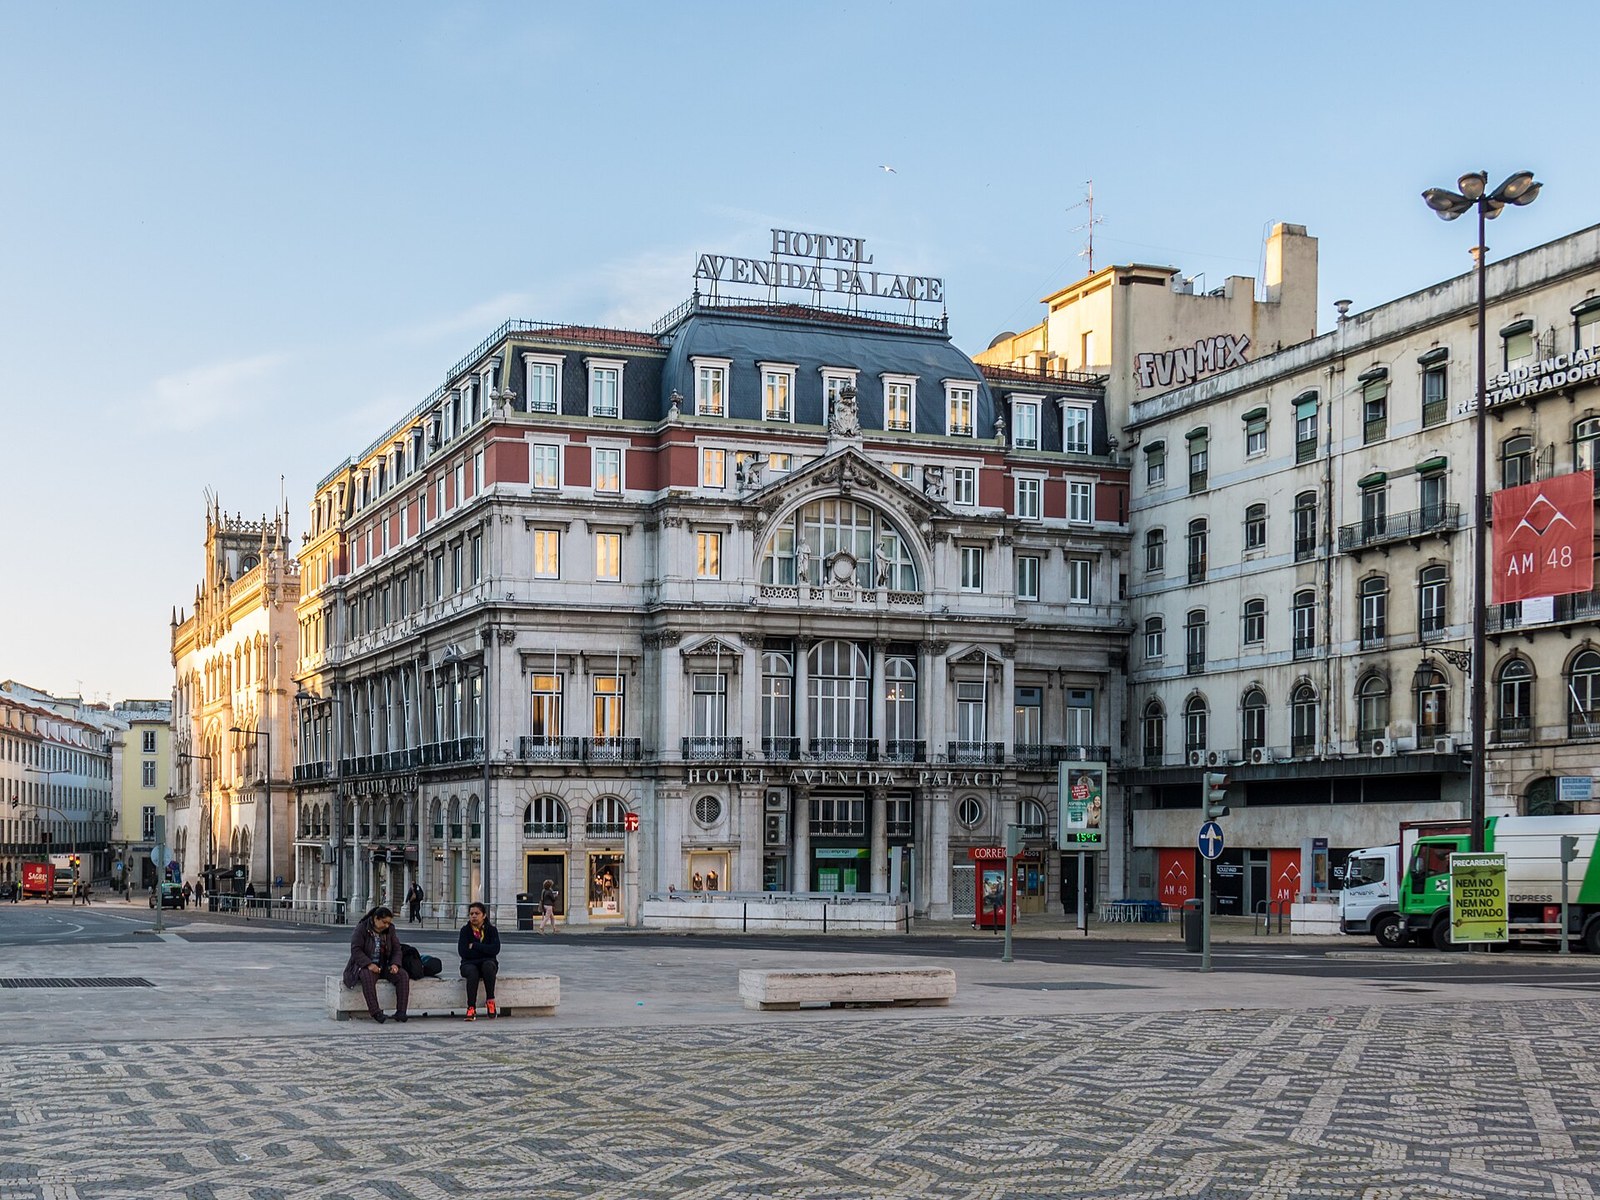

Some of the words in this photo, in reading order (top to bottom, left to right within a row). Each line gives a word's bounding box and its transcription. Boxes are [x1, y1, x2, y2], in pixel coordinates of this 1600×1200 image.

[771, 228, 873, 264] HOTEL
[692, 253, 825, 291] AVENIDA
[834, 267, 942, 302] PALACE
[1475, 345, 1600, 393] ESIDENCIAL
[1507, 553, 1533, 576] AM
[1547, 546, 1571, 568] 48
[688, 768, 769, 784] HOTEL
[787, 769, 896, 786] AVENIDA
[917, 770, 1003, 787] PALACE
[1452, 859, 1504, 867] PRECARIEDADE
[1456, 878, 1477, 888] NEM
[1479, 878, 1493, 887] NO
[1164, 884, 1175, 896] AM
[1177, 885, 1188, 896] 48
[1277, 888, 1290, 899] AM
[1462, 888, 1500, 898] ESTADO
[1456, 899, 1478, 908] NEM
[1479, 898, 1494, 907] NO
[1509, 894, 1552, 902] TOPRESS
[1461, 908, 1504, 918] PRIVADO
